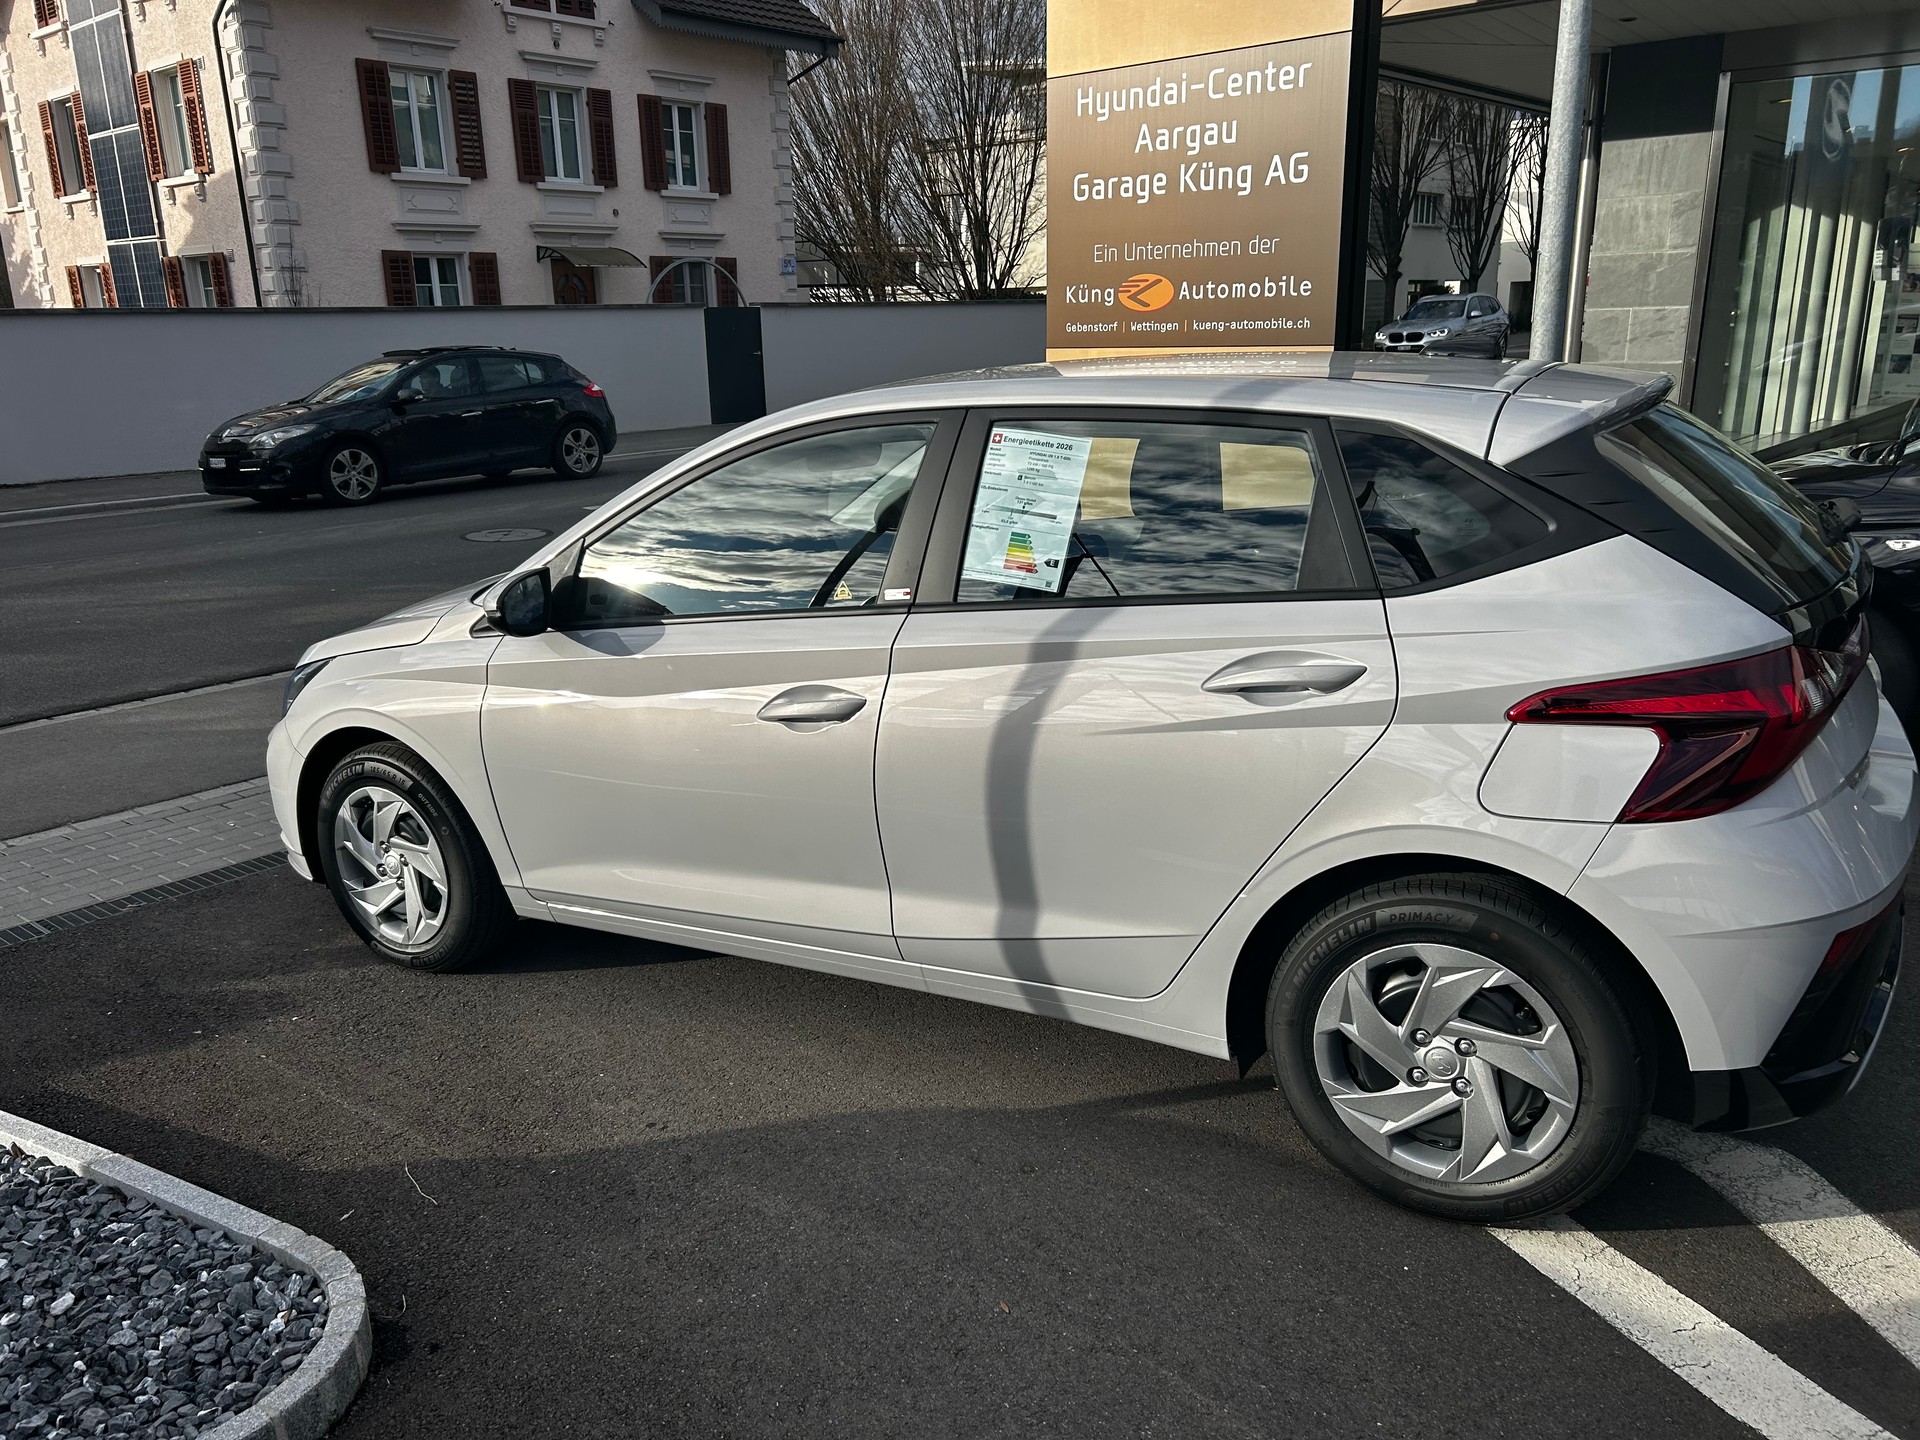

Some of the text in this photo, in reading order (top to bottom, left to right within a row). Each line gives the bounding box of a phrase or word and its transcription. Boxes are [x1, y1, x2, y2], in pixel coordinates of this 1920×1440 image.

[1076, 61, 1312, 122] Hyundai-Center
[1134, 120, 1238, 156] Aargau
[1073, 151, 1310, 204] Garage Küng AG
[1093, 234, 1280, 263] Ein Unternehmen der
[1065, 275, 1312, 307] Küng Automobile
[1065, 317, 1311, 333] Gebenstorf Wettingen kueng-automobile.ch
[1003, 435, 1074, 451] Energieetikette 2026
[325, 763, 363, 799] MICHELIN
[398, 776, 406, 786] 15
[417, 792, 439, 818] OUTSIDE
[1292, 915, 1372, 988] MICHELIN
[1389, 911, 1455, 923] PRIMACY
